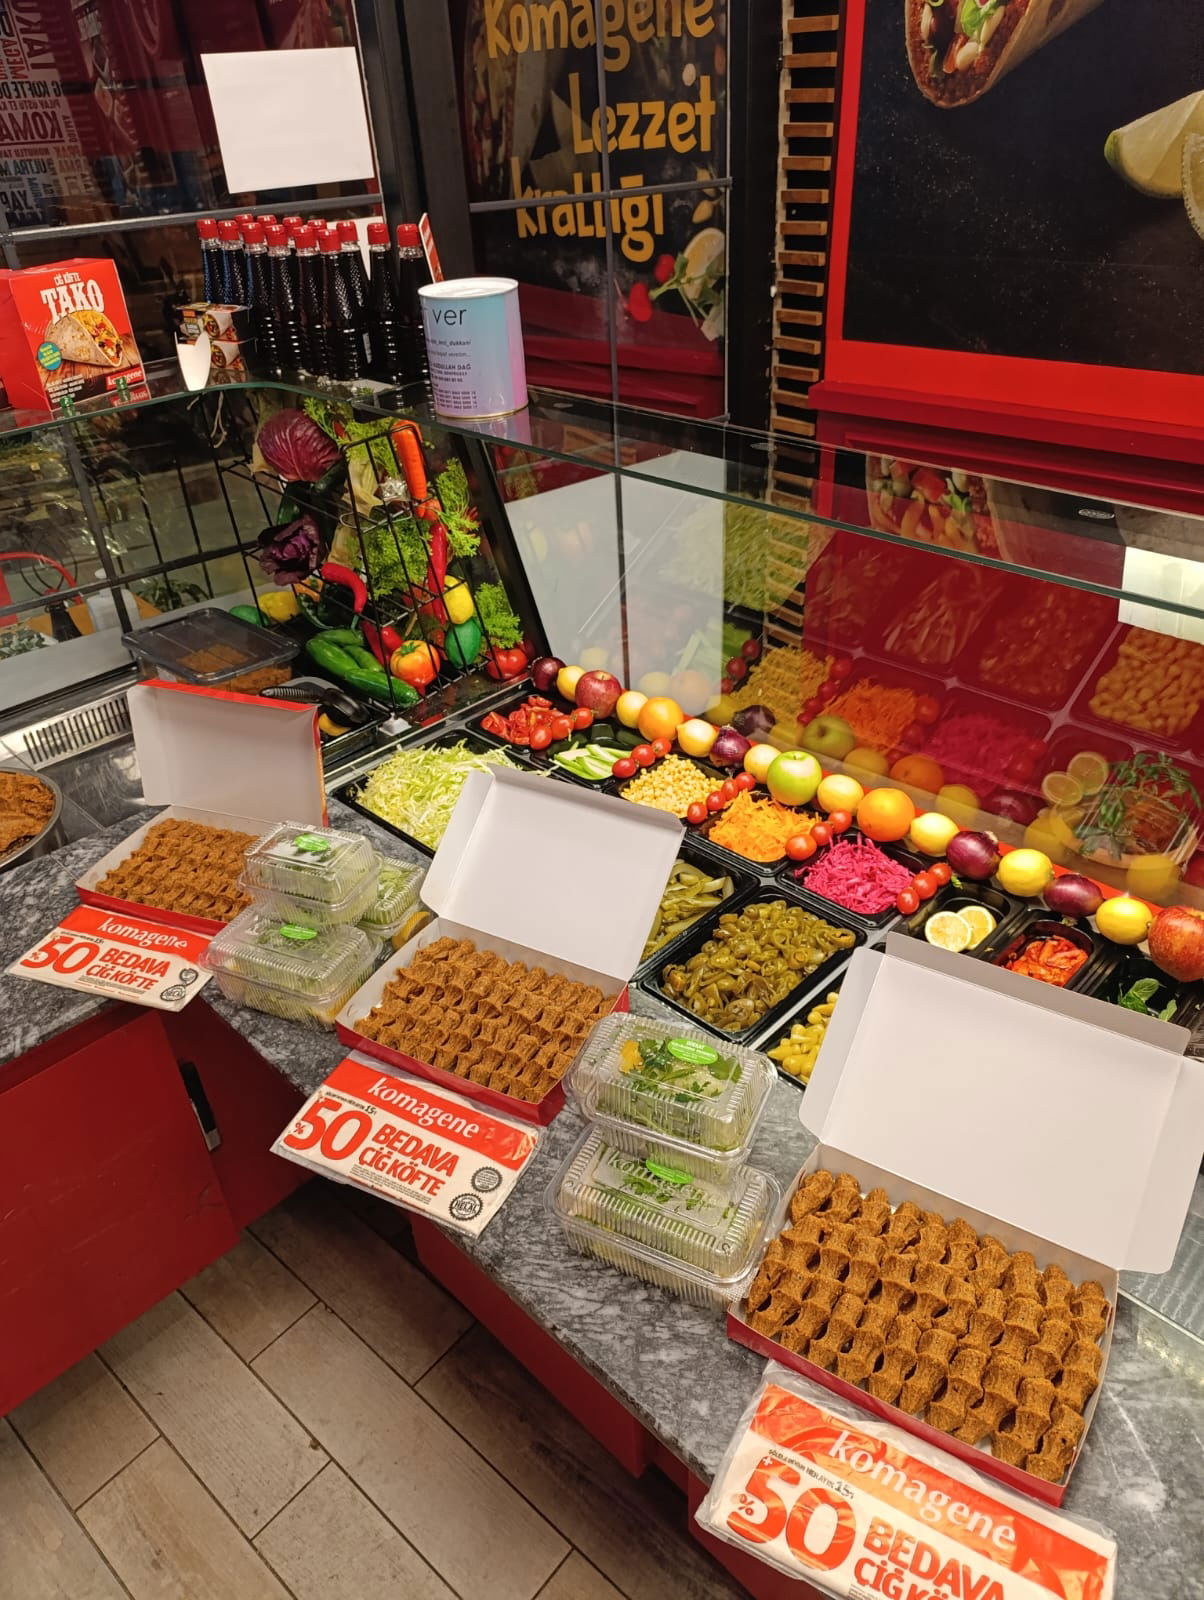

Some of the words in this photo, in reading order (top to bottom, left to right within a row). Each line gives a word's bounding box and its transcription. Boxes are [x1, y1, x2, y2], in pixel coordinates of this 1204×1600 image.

[568, 72, 716, 155] Lezzet
[40, 279, 105, 325] TAKO
[432, 307, 468, 326] ver
[97, 917, 188, 949] komagene
[99, 947, 171, 978] BEDAVA
[111, 968, 159, 991] KÖFTE
[367, 1077, 481, 1139] komagene
[358, 1146, 392, 1172] ÇİĞ
[386, 1158, 446, 1197] KÖFTE
[372, 1123, 460, 1177] BEDAVA
[828, 1429, 1016, 1550] komagene
